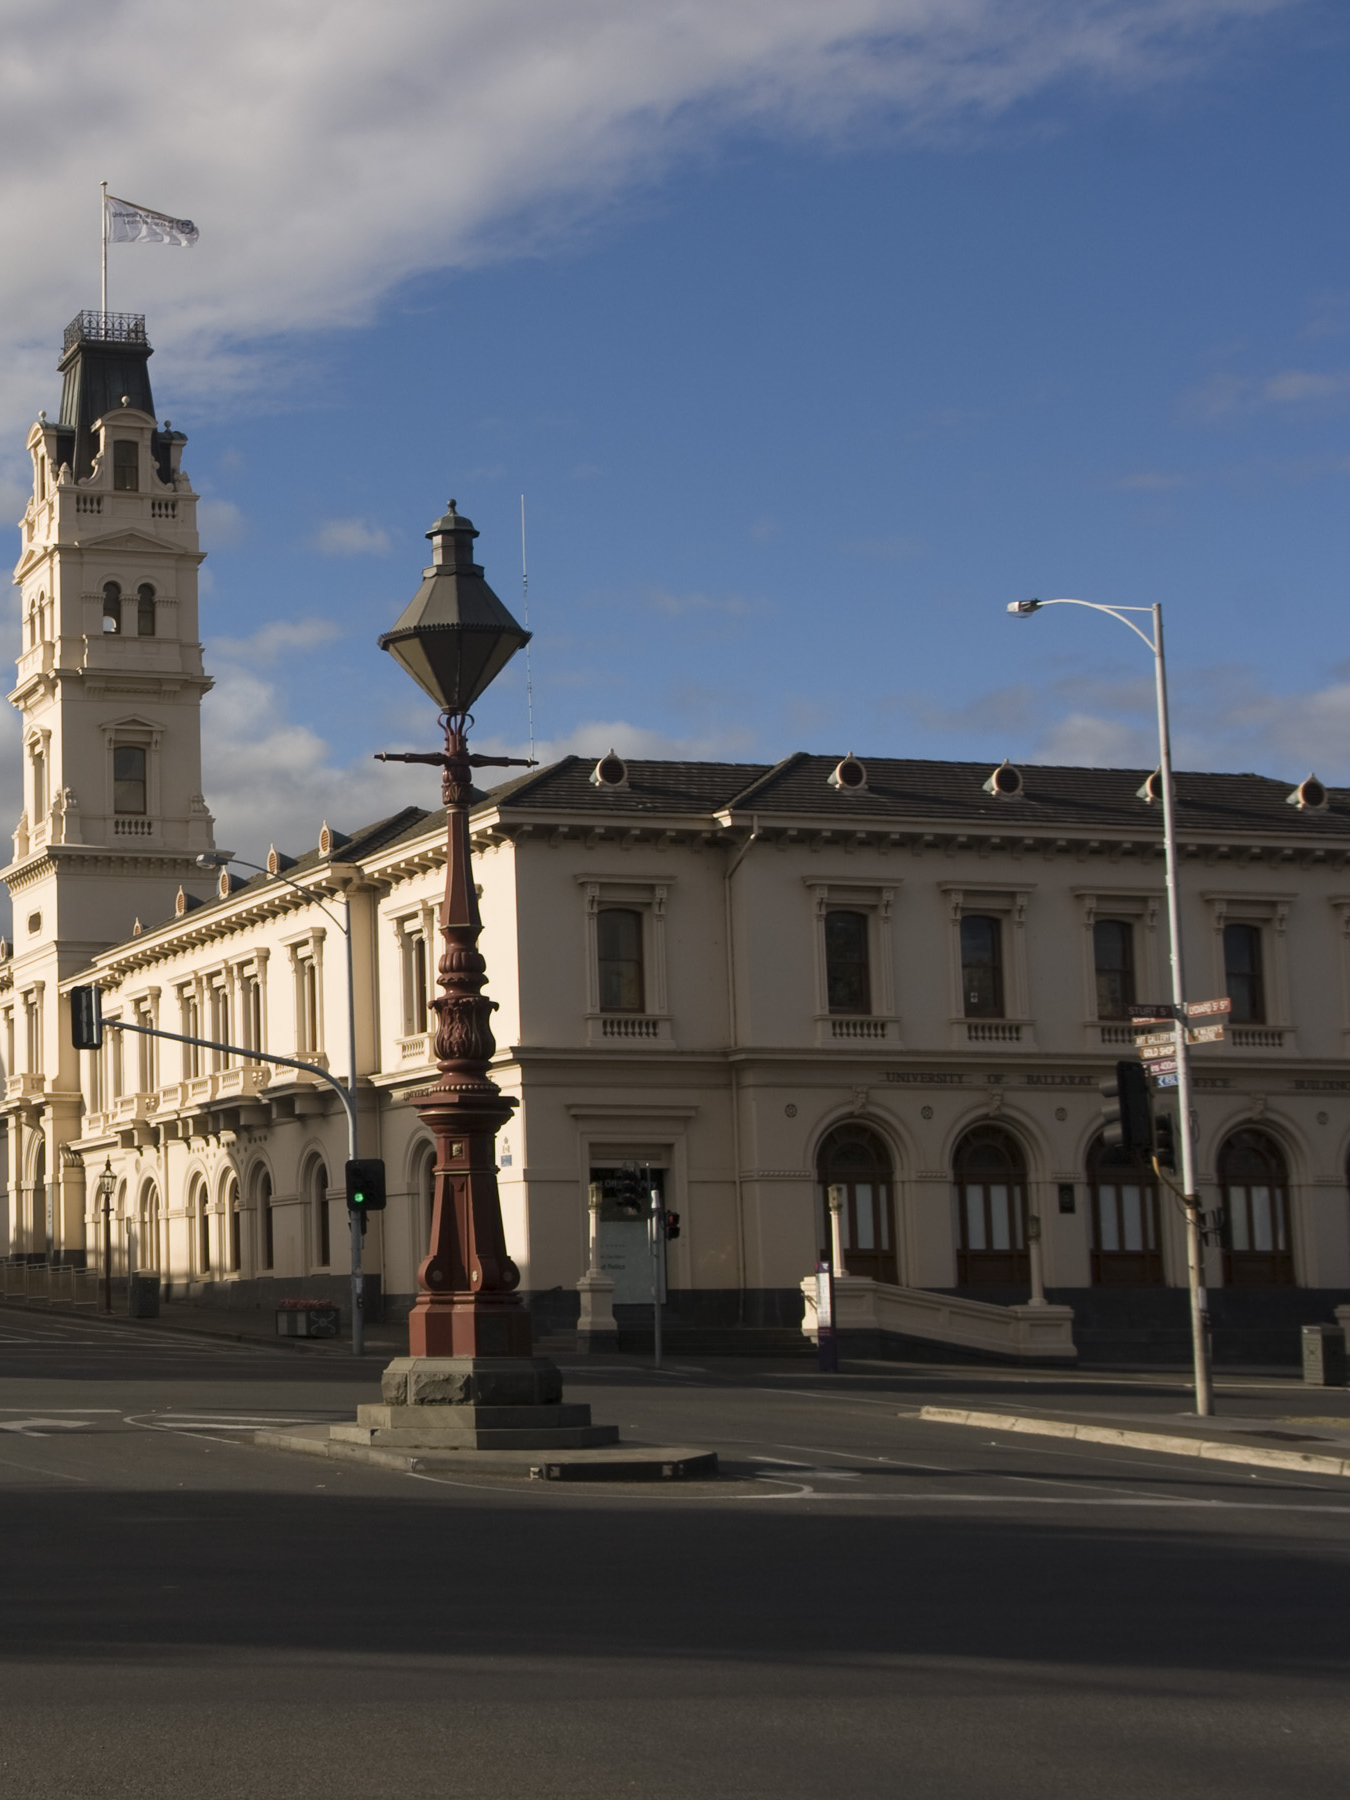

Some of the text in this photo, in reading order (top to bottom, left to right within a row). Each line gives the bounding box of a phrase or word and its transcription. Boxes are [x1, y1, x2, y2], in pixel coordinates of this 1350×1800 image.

[1128, 1006, 1157, 1015] STURT
[1143, 1046, 1175, 1058] GOLD SHOP
[886, 1072, 964, 1083] UNIVERSITY
[987, 1073, 1004, 1084] OF
[1027, 1074, 1093, 1086] BALLARAT
